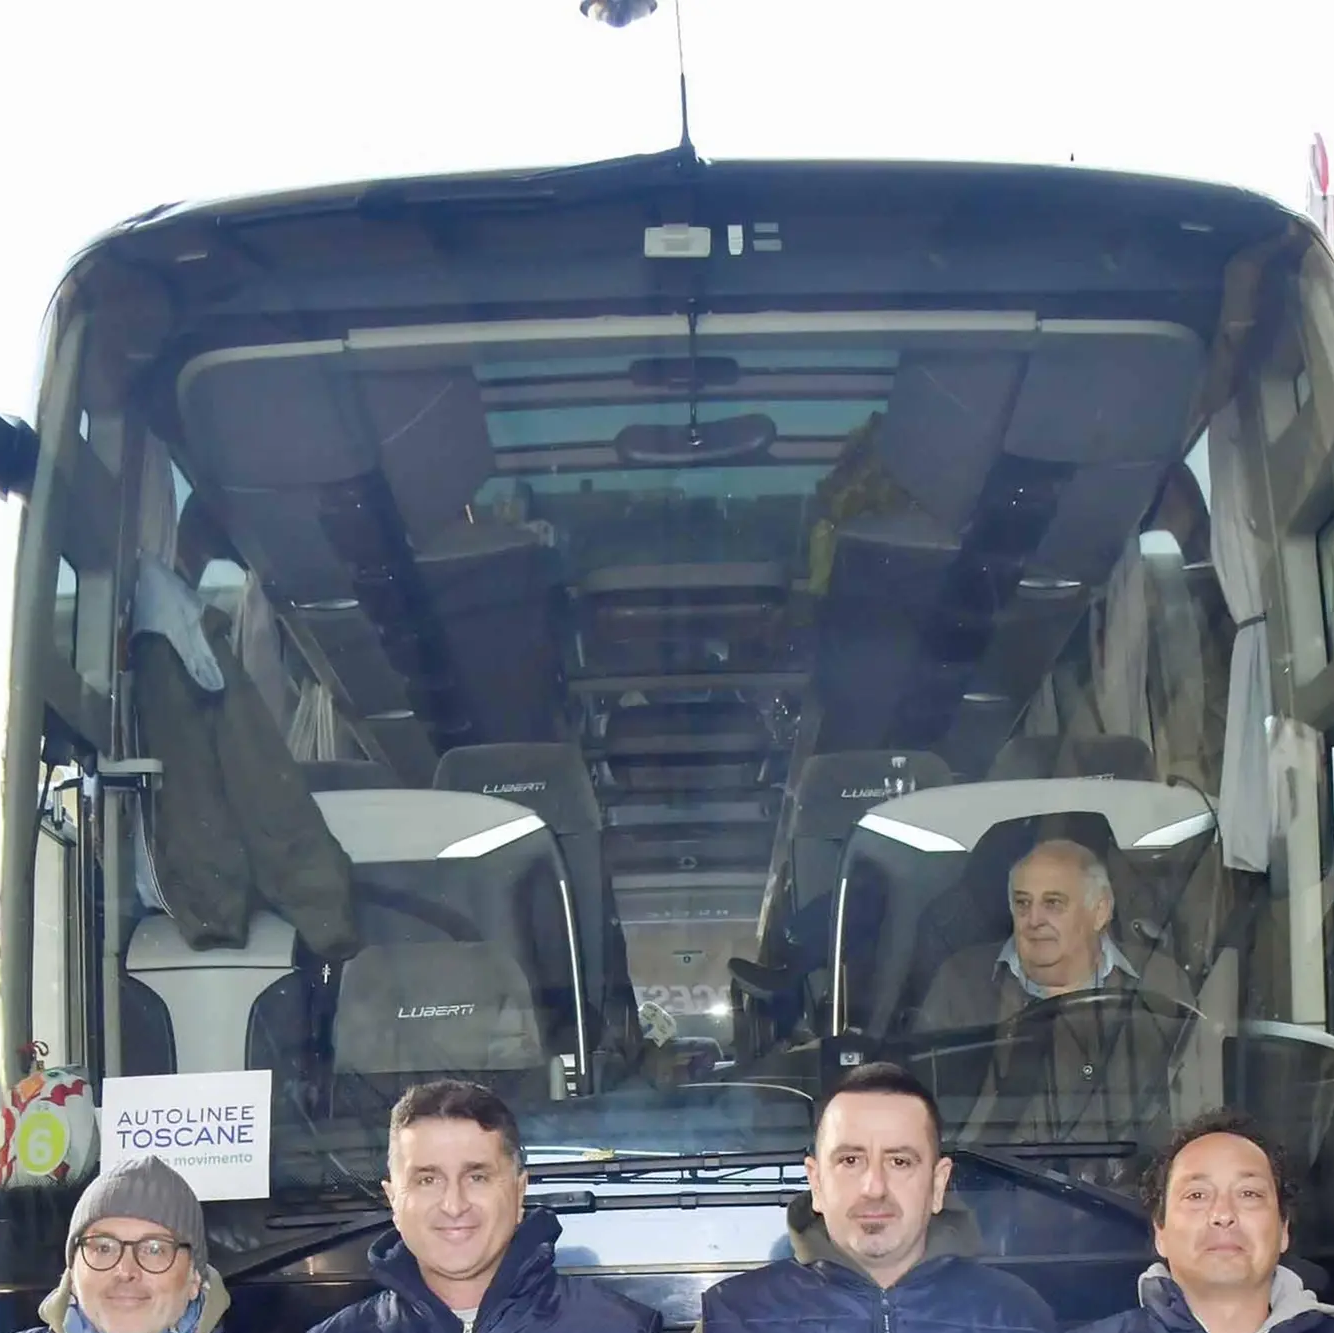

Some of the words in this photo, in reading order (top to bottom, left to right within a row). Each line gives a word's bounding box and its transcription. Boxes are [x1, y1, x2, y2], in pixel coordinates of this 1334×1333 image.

[483, 781, 547, 794] LUBERTI
[398, 1003, 475, 1018] LUBERTI
[117, 1106, 255, 1126] AUTOLINEE
[117, 1124, 253, 1149] TOSCANE
[28, 1127, 53, 1165] 6
[174, 1152, 253, 1166] movimento
